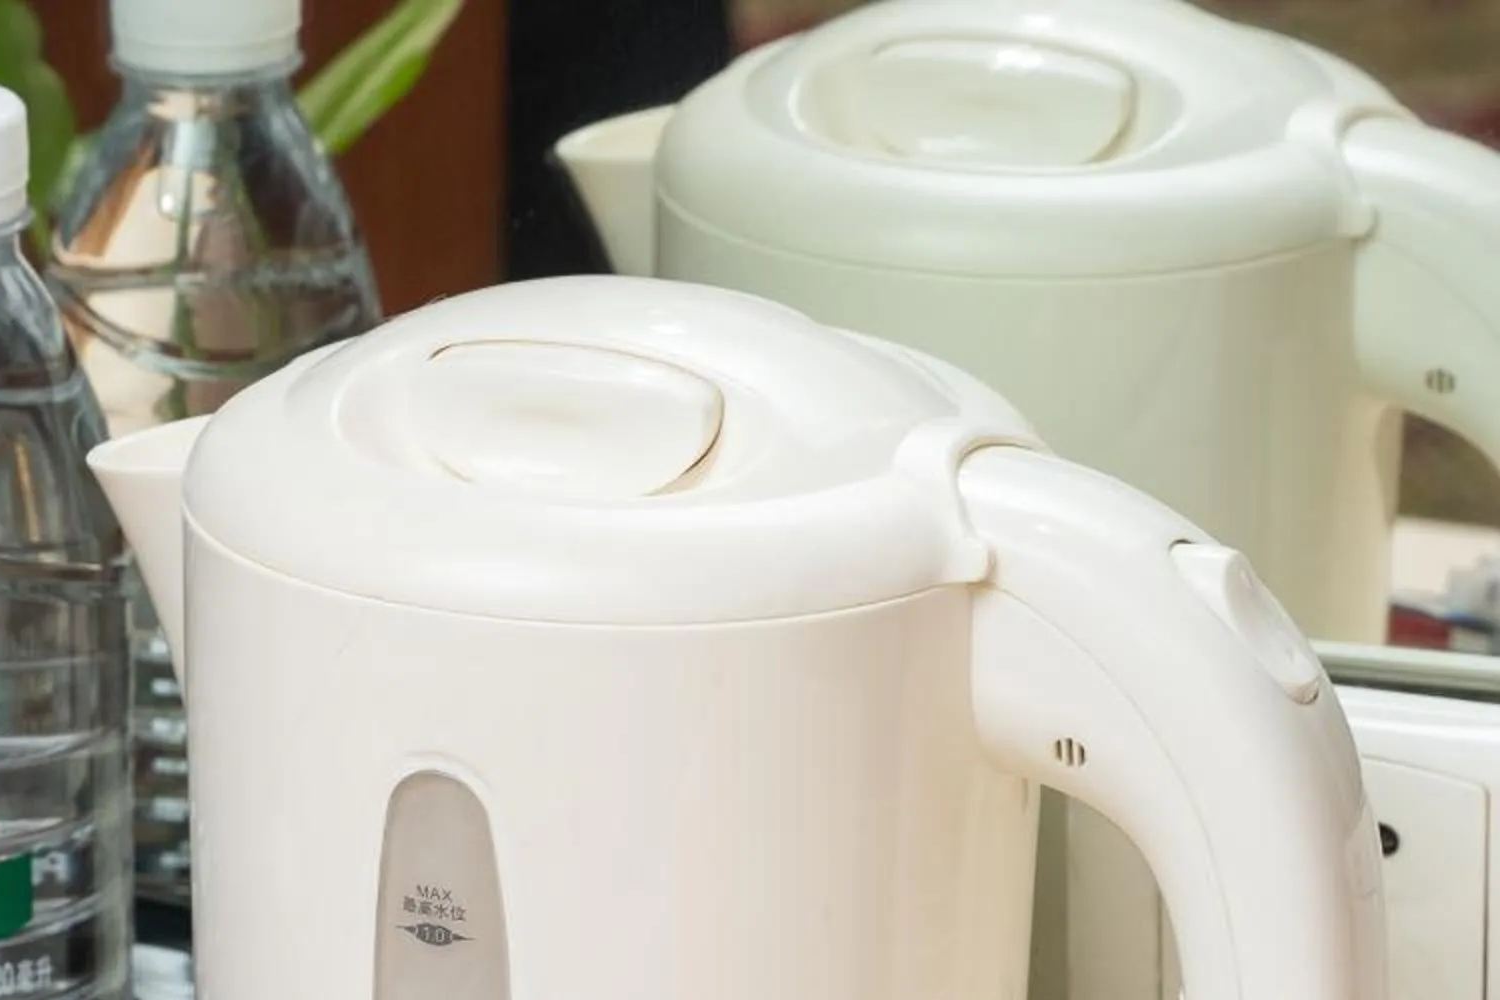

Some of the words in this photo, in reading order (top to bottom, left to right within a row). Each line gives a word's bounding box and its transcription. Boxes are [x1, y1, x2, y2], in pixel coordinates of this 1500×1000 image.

[416, 884, 453, 903] MAX
[403, 896, 467, 922] 最高水位
